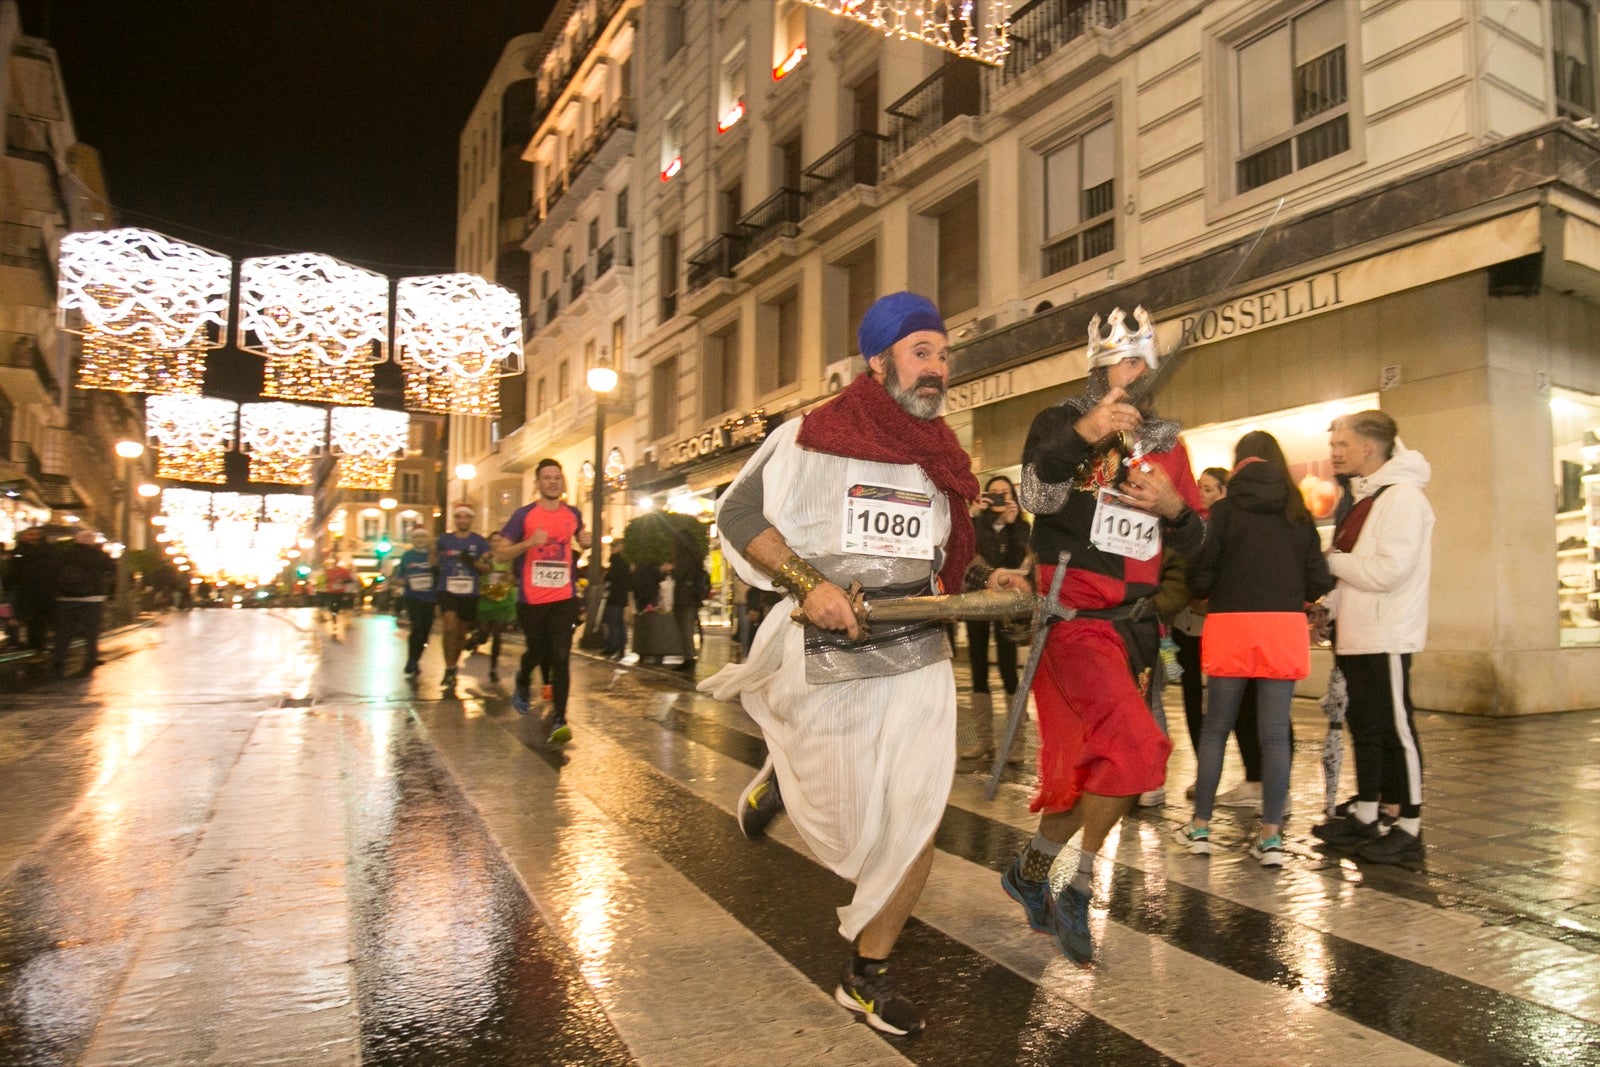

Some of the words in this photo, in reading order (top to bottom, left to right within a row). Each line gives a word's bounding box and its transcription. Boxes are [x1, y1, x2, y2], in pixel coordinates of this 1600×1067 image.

[1180, 271, 1345, 347] ROSSELLI
[945, 371, 1015, 411] SSELLI
[857, 509, 921, 538] 1080
[1104, 515, 1155, 544] 1014
[538, 571, 566, 580] 1427
